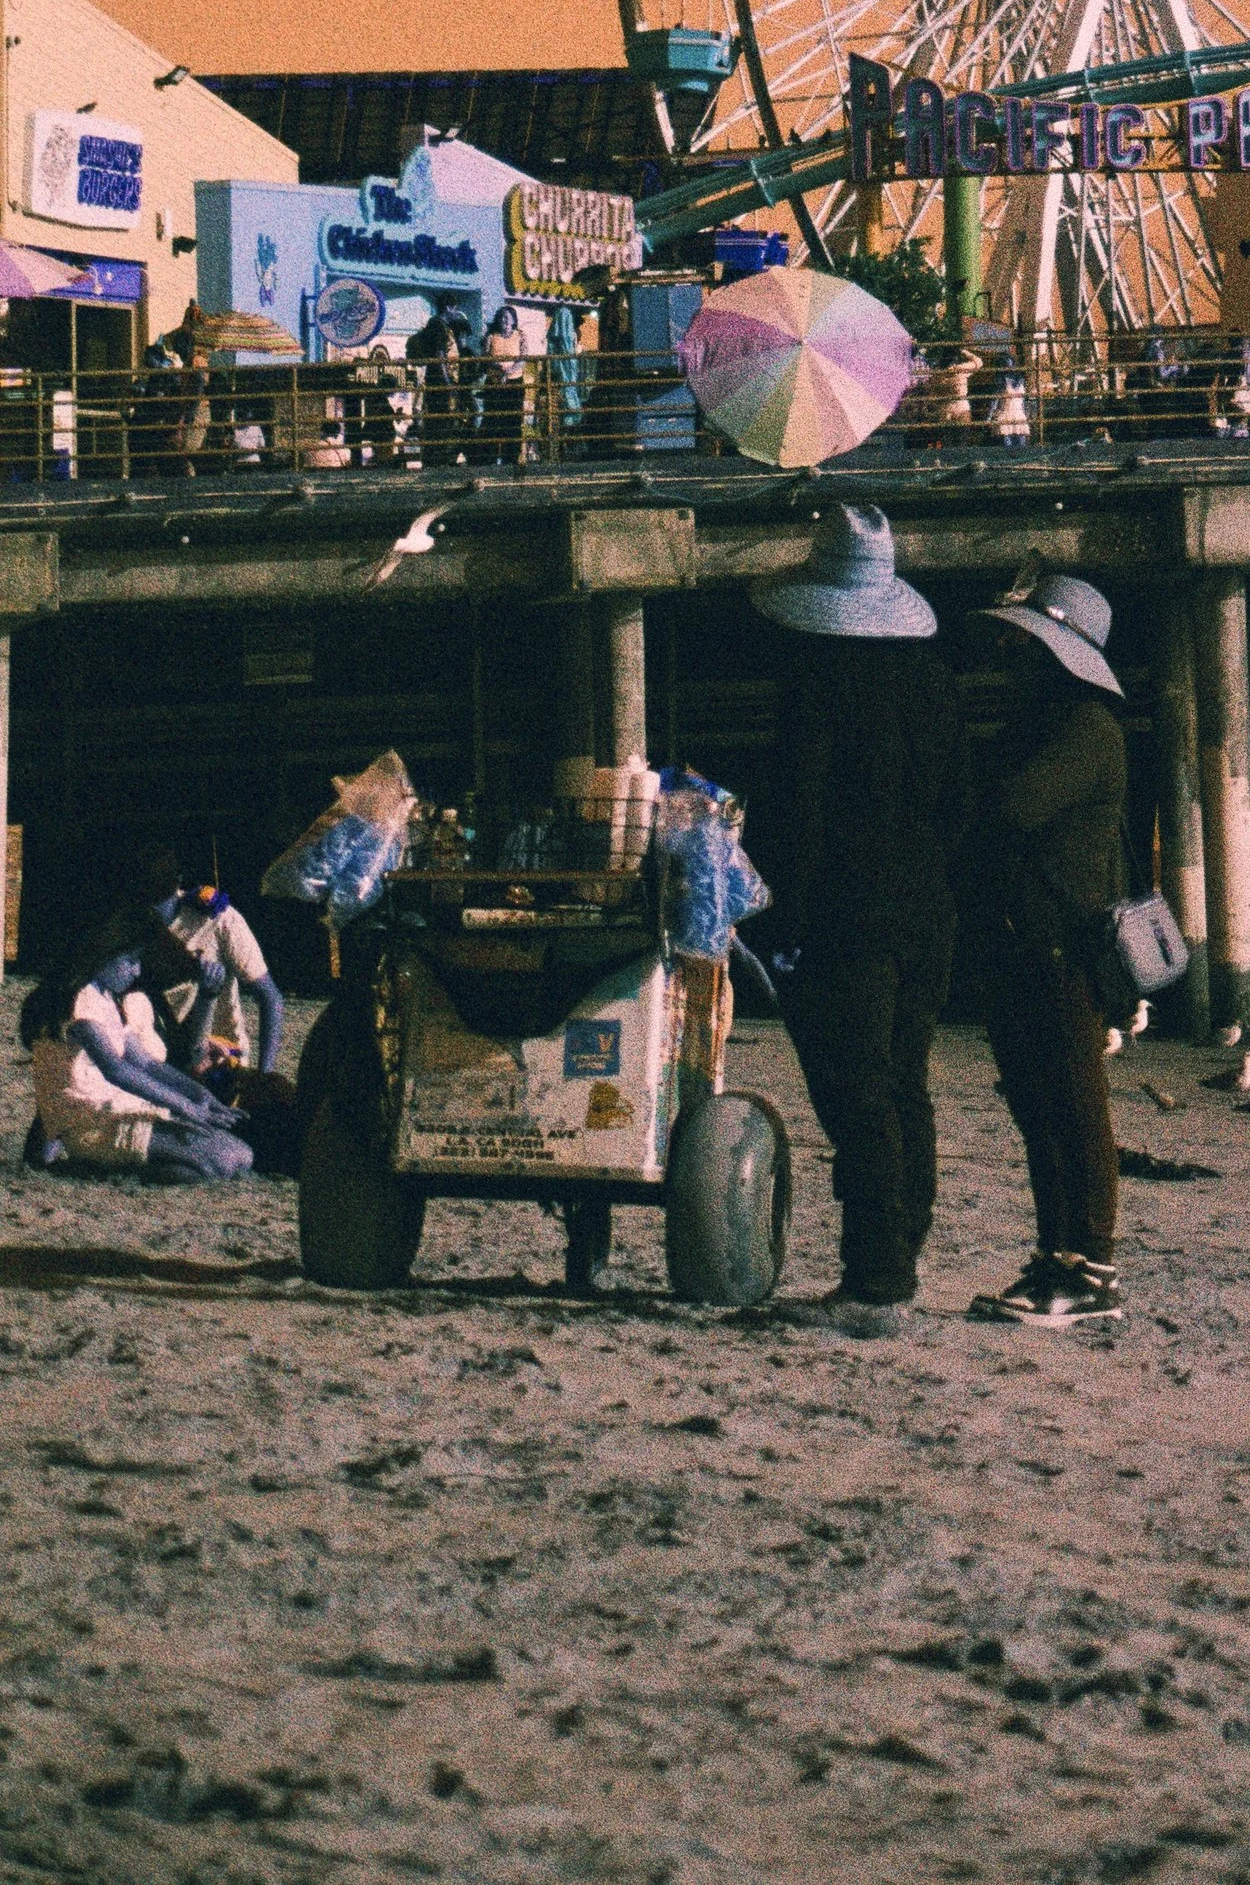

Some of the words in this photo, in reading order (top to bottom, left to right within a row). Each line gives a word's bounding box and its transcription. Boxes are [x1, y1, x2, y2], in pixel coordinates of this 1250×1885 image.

[849, 51, 1145, 181] PACIFIC
[76, 168, 143, 213] BURGERS
[369, 184, 412, 224] The
[522, 182, 635, 242] CHURRITA
